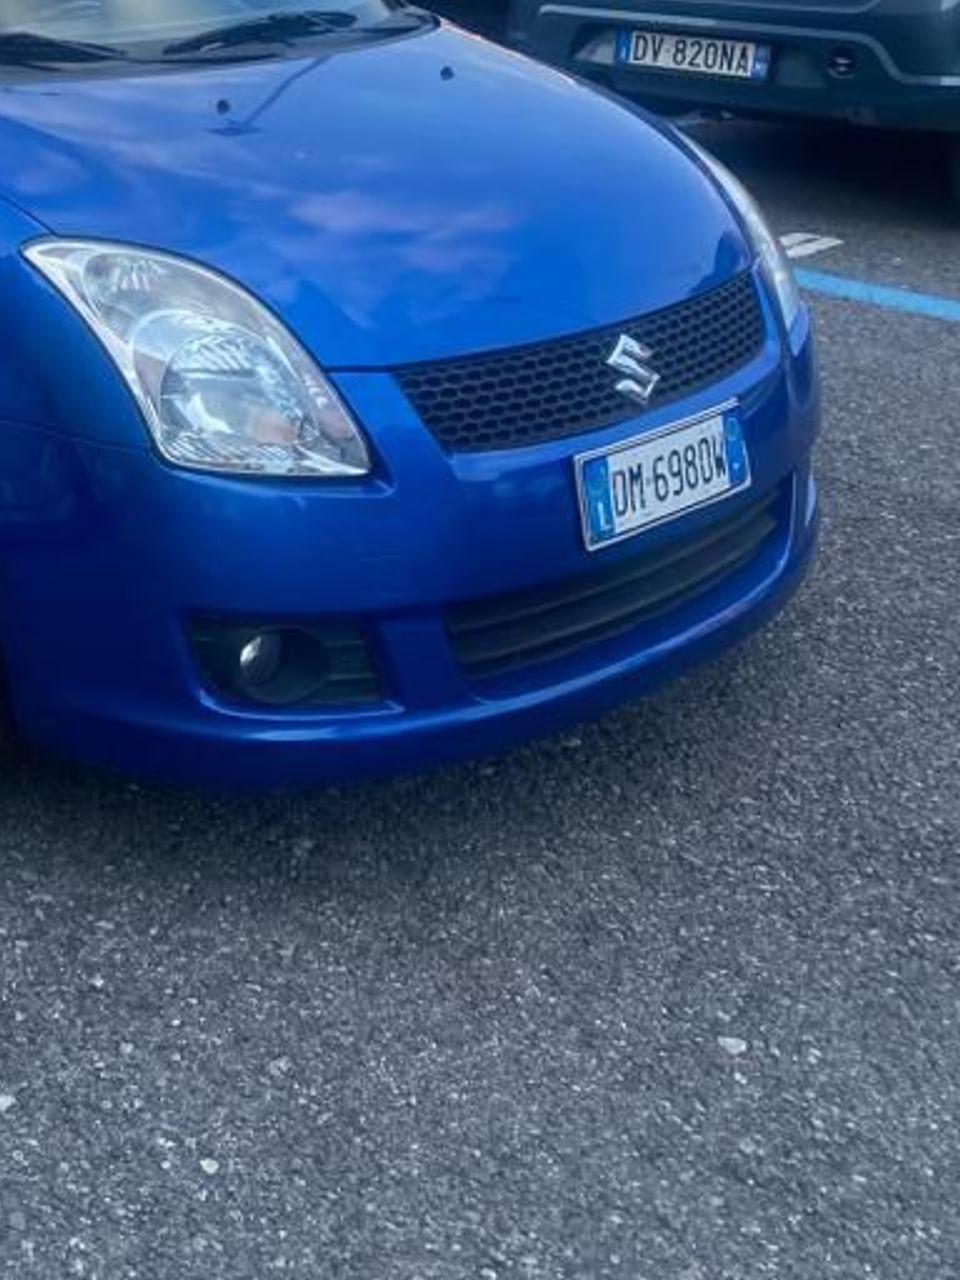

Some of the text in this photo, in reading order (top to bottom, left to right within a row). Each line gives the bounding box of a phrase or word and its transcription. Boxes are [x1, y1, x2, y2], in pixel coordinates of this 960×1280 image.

[633, 35, 663, 62] DV
[673, 40, 748, 74] 820NA
[612, 463, 645, 517] DM
